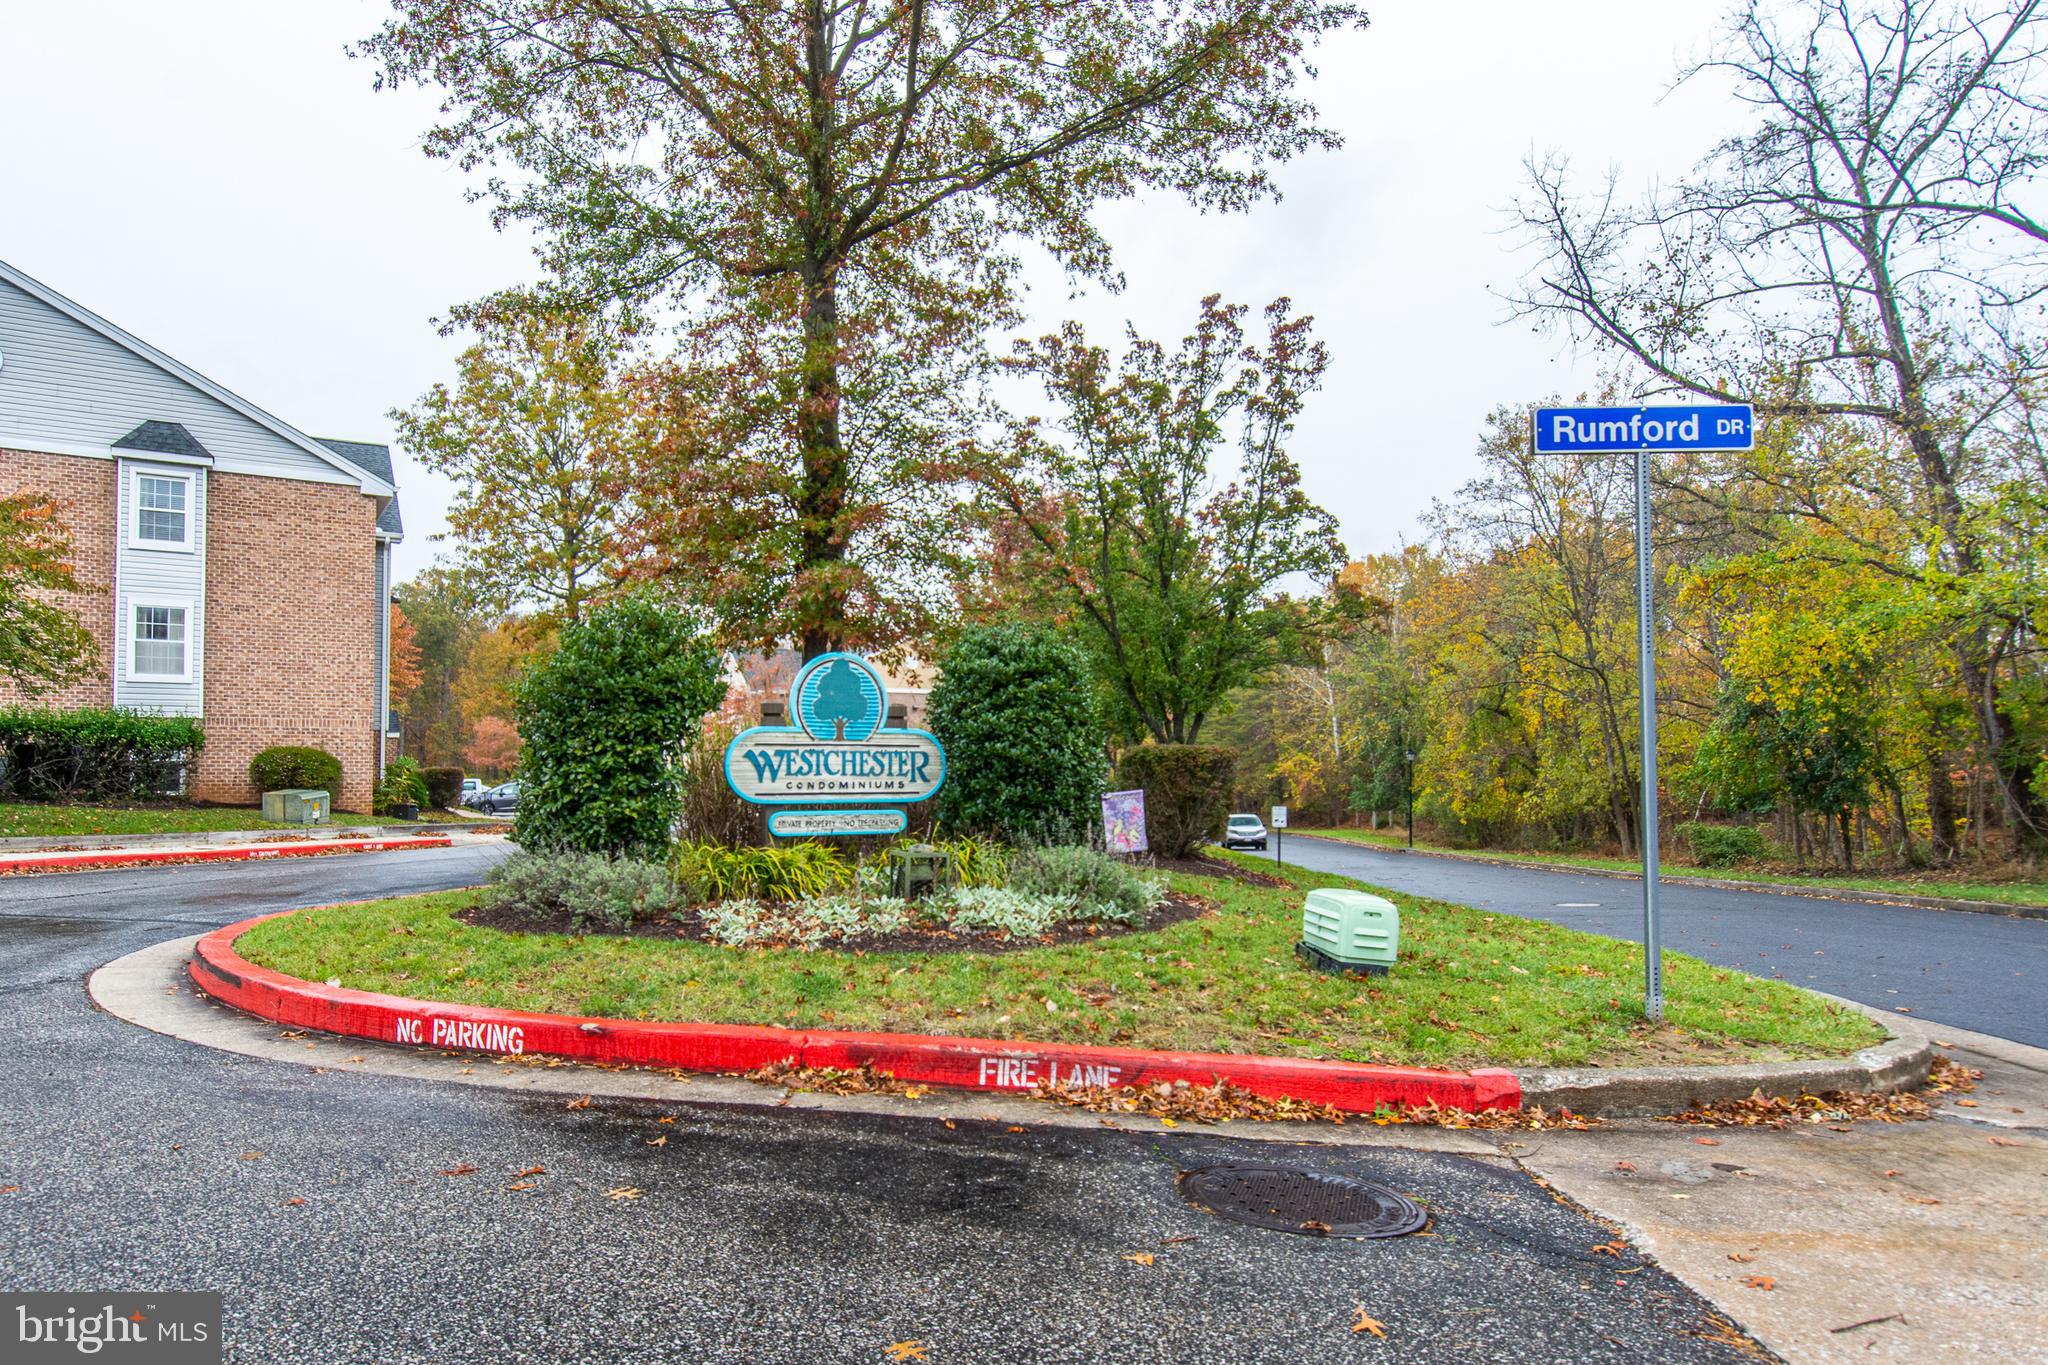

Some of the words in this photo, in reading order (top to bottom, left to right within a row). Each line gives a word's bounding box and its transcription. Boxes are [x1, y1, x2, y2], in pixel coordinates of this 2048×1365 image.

[1553, 413, 1699, 443] Rumford
[1716, 419, 1744, 435] DR
[742, 749, 931, 784] WESTCHESTER
[786, 781, 905, 790] CONDOMINIUMS
[805, 820, 836, 828] PROPERTY
[432, 1018, 524, 1054] PARKING
[979, 1057, 1039, 1088] FIRE
[1050, 1060, 1121, 1089] LANE
